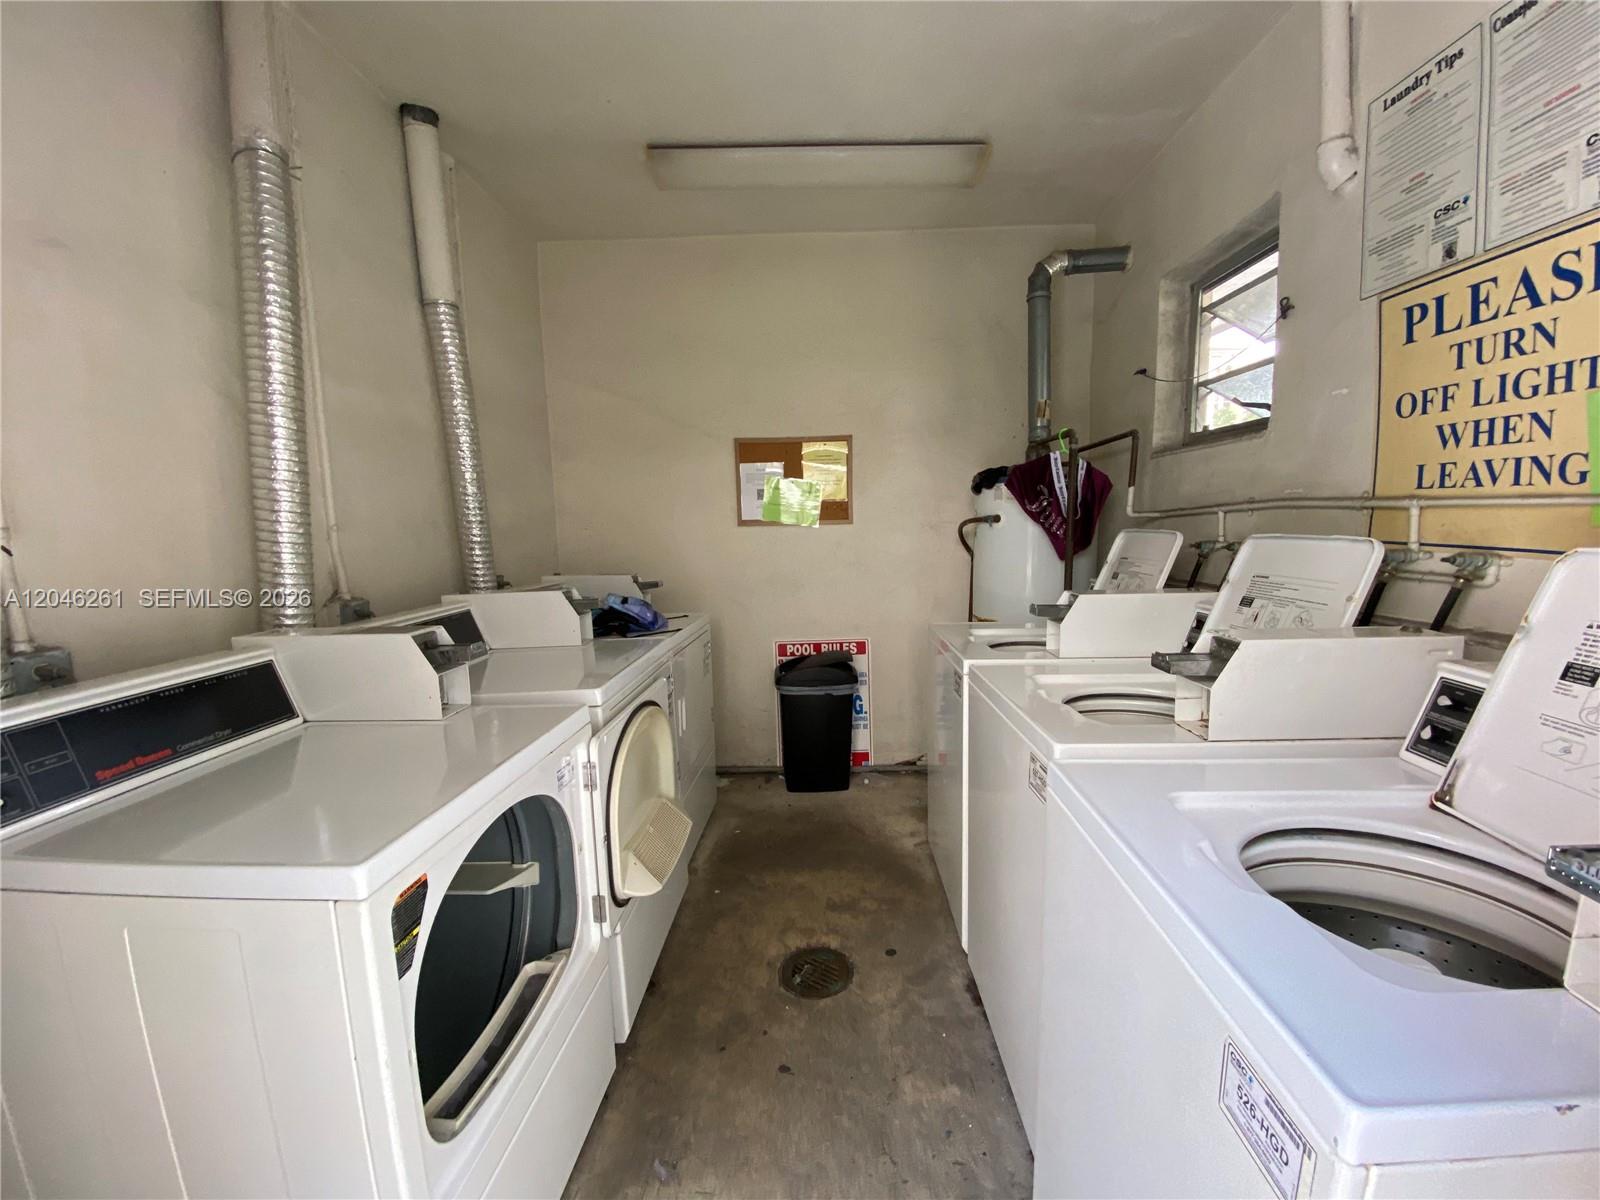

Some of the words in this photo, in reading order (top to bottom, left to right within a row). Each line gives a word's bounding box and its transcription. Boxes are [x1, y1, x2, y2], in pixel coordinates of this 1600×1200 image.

[1383, 70, 1432, 112] Laundry
[1434, 48, 1464, 77] Tips
[1433, 199, 1461, 220] CSC
[1450, 317, 1560, 371] TURN
[1395, 383, 1460, 419] OFF
[1436, 409, 1557, 450] WHEN
[1414, 452, 1591, 490] LEAVING
[786, 643, 817, 656] POOL
[1236, 1084, 1290, 1168] 526-HGD
